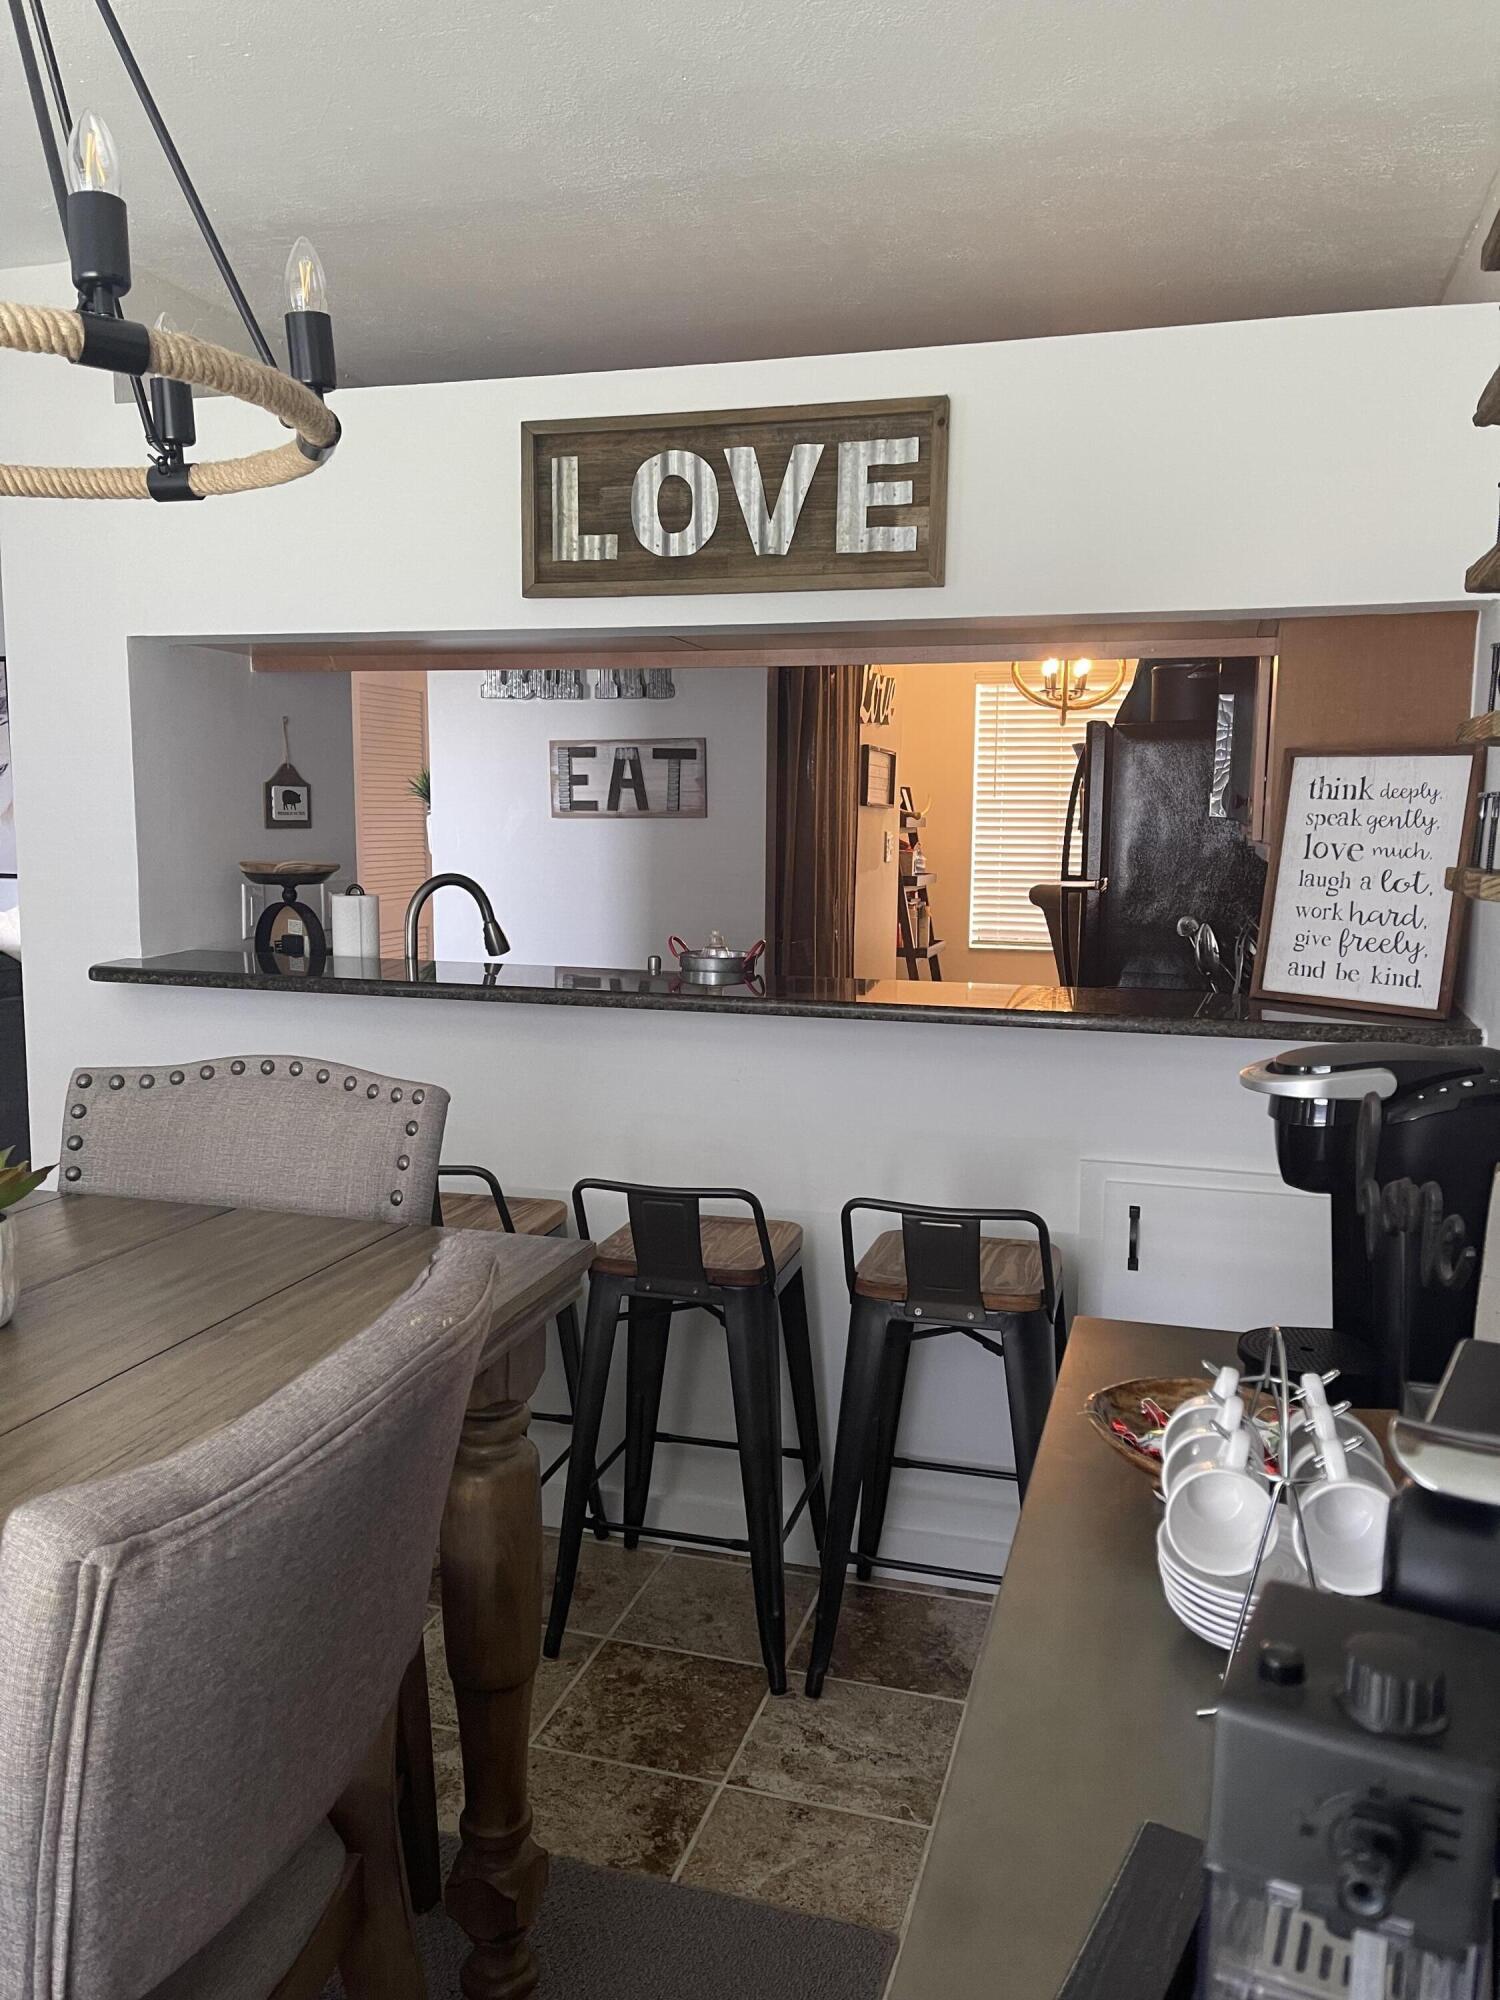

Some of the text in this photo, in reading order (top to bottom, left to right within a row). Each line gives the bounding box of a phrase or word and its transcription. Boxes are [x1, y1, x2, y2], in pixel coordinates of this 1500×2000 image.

[551, 437, 920, 562] LOVE
[557, 746, 697, 812] EAT
[1308, 775, 1375, 801] think
[1305, 808, 1363, 830] speak
[1302, 832, 1364, 862] love
[1297, 868, 1433, 897] laugh a lot,
[1295, 900, 1428, 930] work hard,
[1293, 927, 1429, 965] give freely,
[1287, 960, 1423, 989] and be kind.
